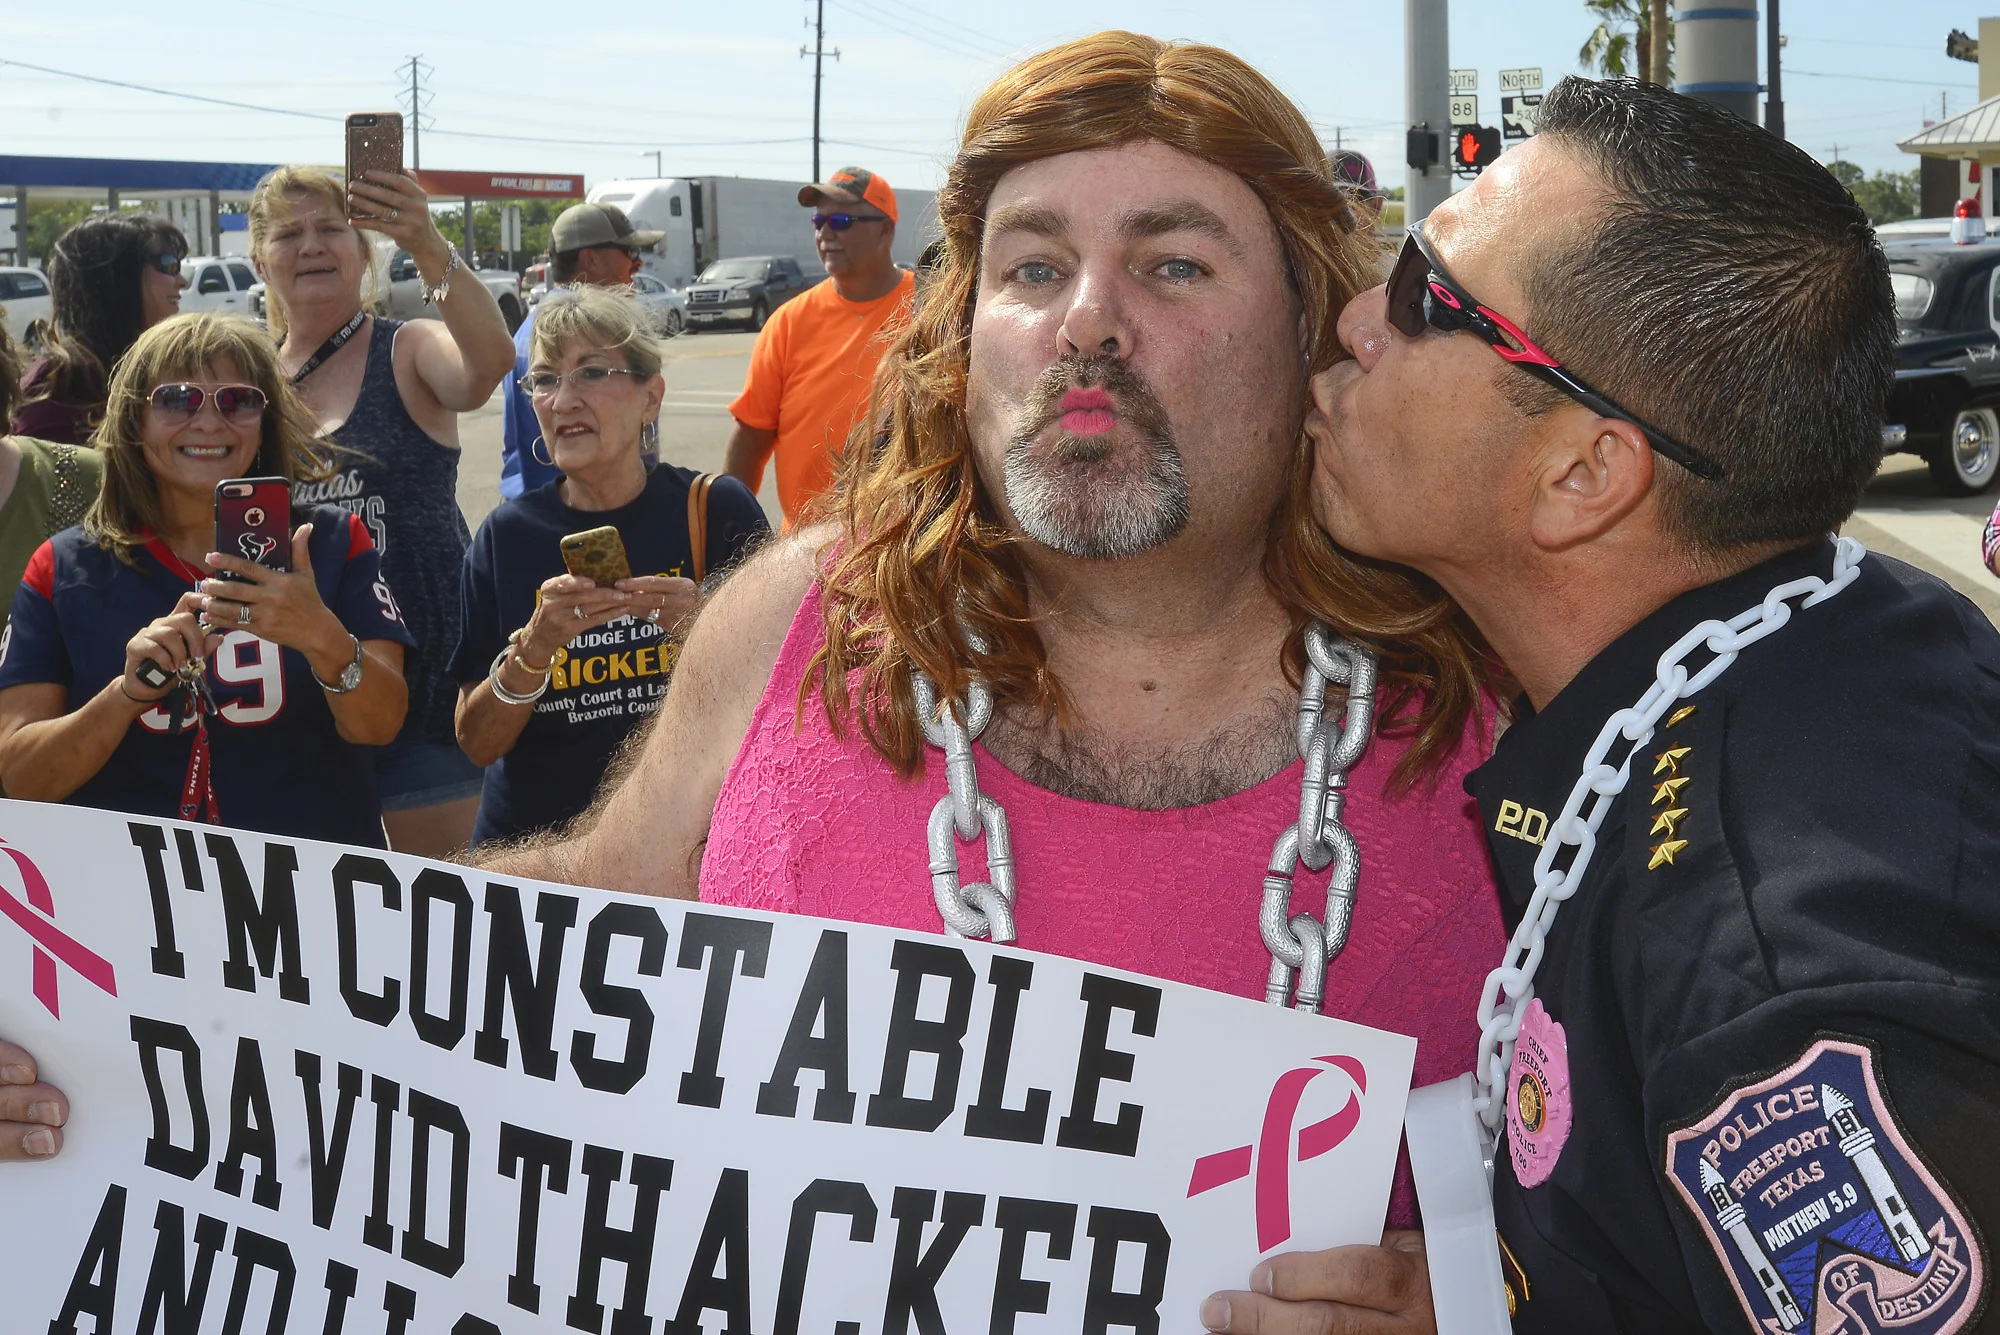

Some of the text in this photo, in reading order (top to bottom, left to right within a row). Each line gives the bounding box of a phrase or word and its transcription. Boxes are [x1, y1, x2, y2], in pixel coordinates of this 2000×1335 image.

[1449, 75, 1475, 87] OUTH
[1502, 74, 1540, 87] NORTH
[1452, 103, 1472, 116] 88
[568, 704, 623, 724] Brazoria
[580, 688, 622, 706] Court
[628, 685, 642, 699] at
[648, 683, 669, 697] La
[188, 749, 200, 796] EXANS
[127, 822, 1162, 1157] I'M CONSTABLE
[1528, 1036, 1549, 1065] CHIEF
[1518, 1051, 1553, 1098] FREEPORT
[1512, 1117, 1537, 1154] POLICE
[1702, 1084, 1819, 1170] POLICE
[129, 1014, 1172, 1335] DAVID THACKER
[1515, 1147, 1527, 1169] 700
[1730, 1126, 1830, 1198] FREEPORT
[1759, 1160, 1825, 1209] TEXAS
[1763, 1182, 1858, 1251] MATTHEW 5.9
[46, 1183, 297, 1335] AND
[1831, 1260, 1956, 1319] OF DESTINY
